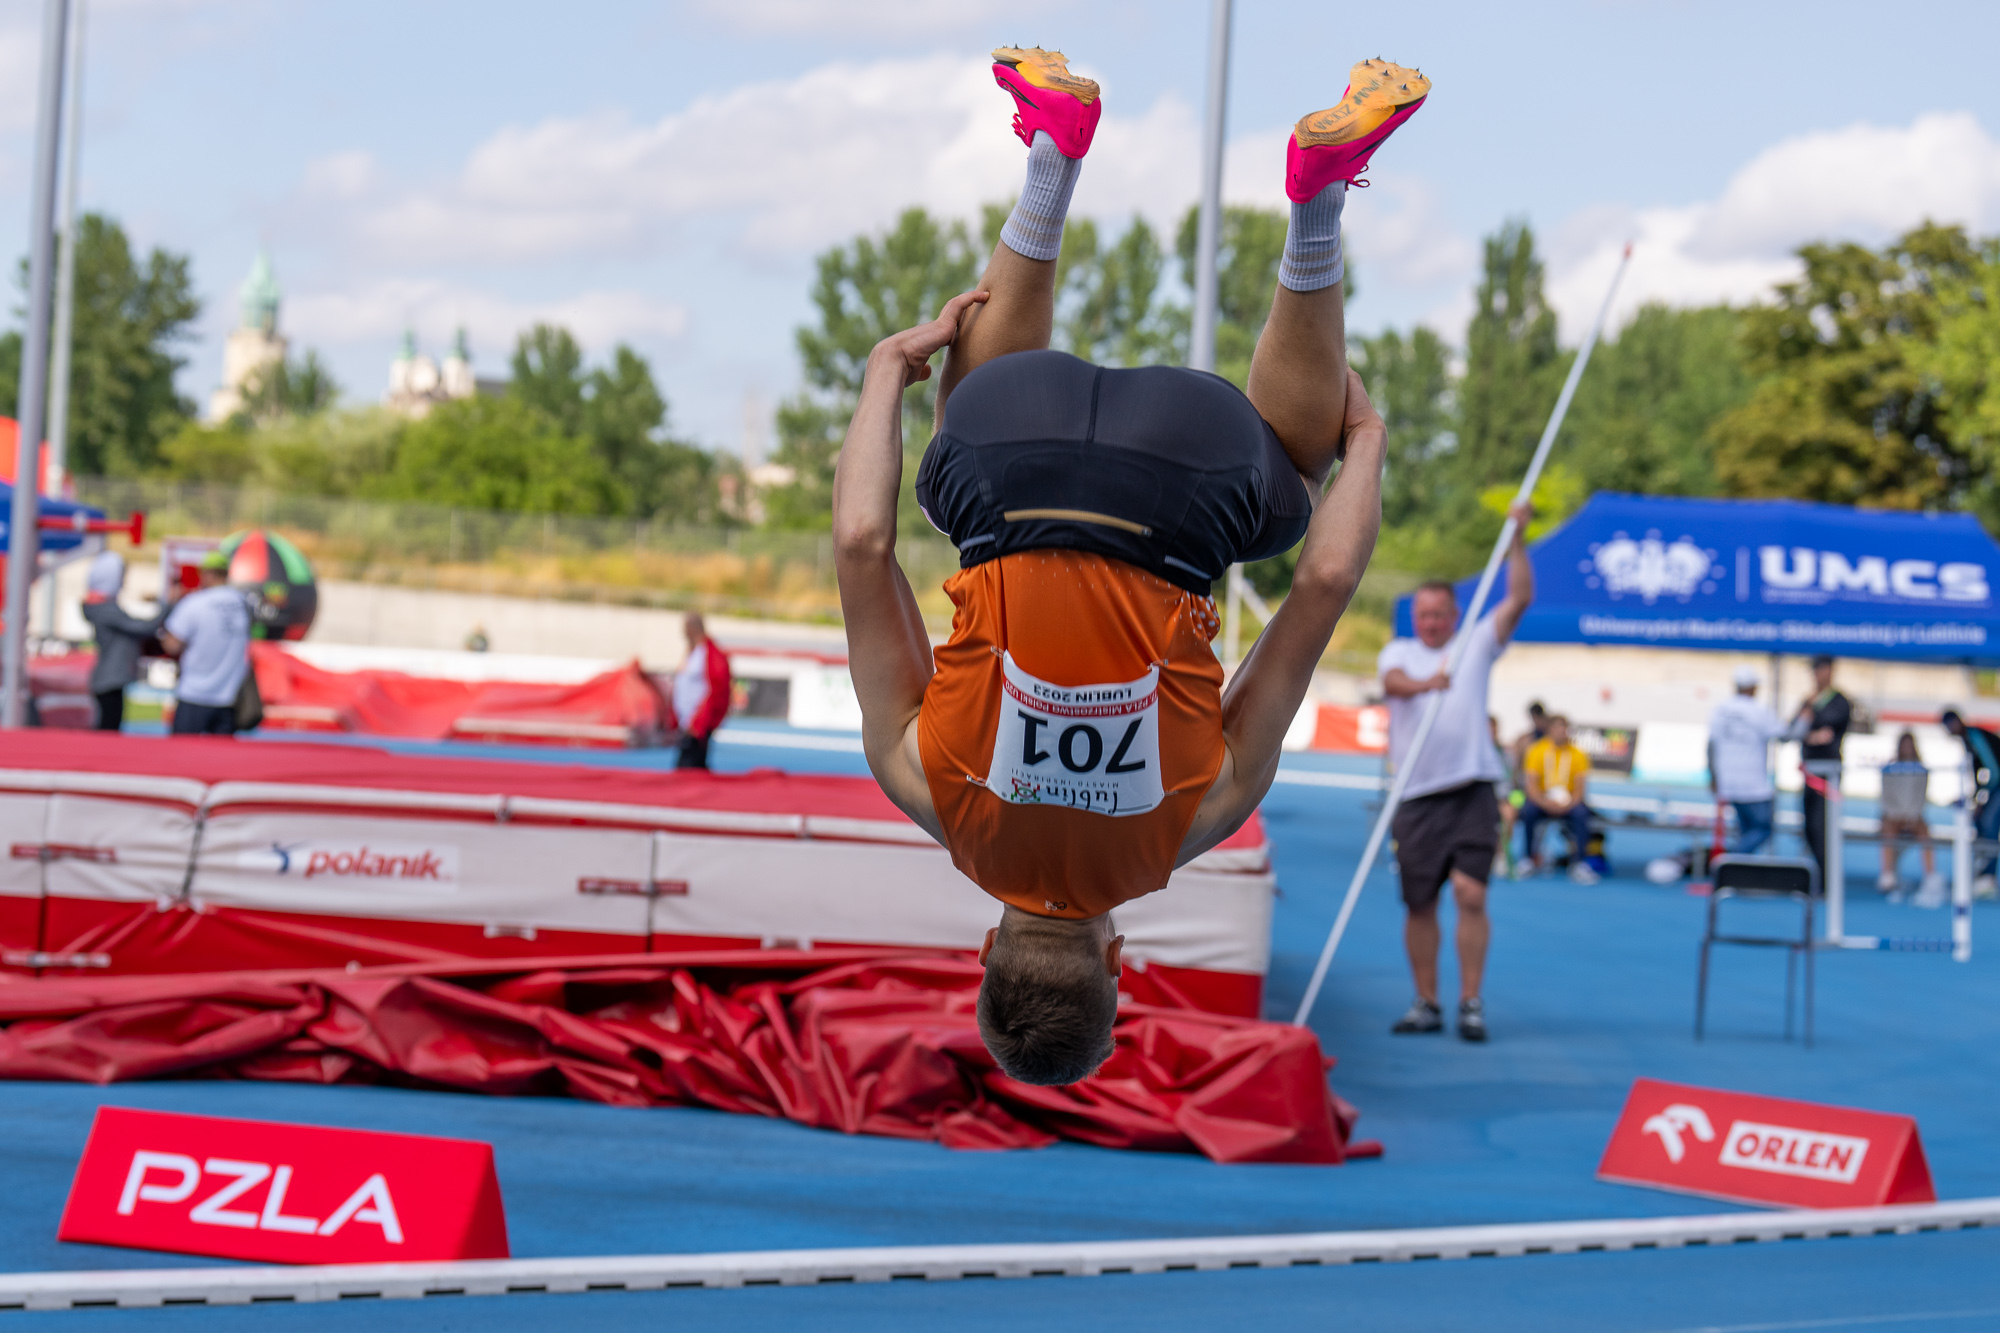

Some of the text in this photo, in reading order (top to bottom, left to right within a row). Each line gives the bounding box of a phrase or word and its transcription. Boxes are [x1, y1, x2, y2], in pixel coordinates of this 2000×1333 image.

[1760, 545, 1989, 601] UMCS
[1005, 680, 1020, 699] U20
[1034, 684, 1131, 703] LUBLIN 2023
[1020, 694, 1049, 712] Polski
[1052, 704, 1121, 716] Mistrzostwa
[1125, 698, 1148, 714] PZLA
[1017, 708, 1146, 775] 701
[1011, 767, 1119, 788] MIASTO INSPIRACJI
[305, 846, 441, 879] polanik
[1735, 1132, 1854, 1173] ORLEN
[116, 1149, 404, 1244] PZLA
